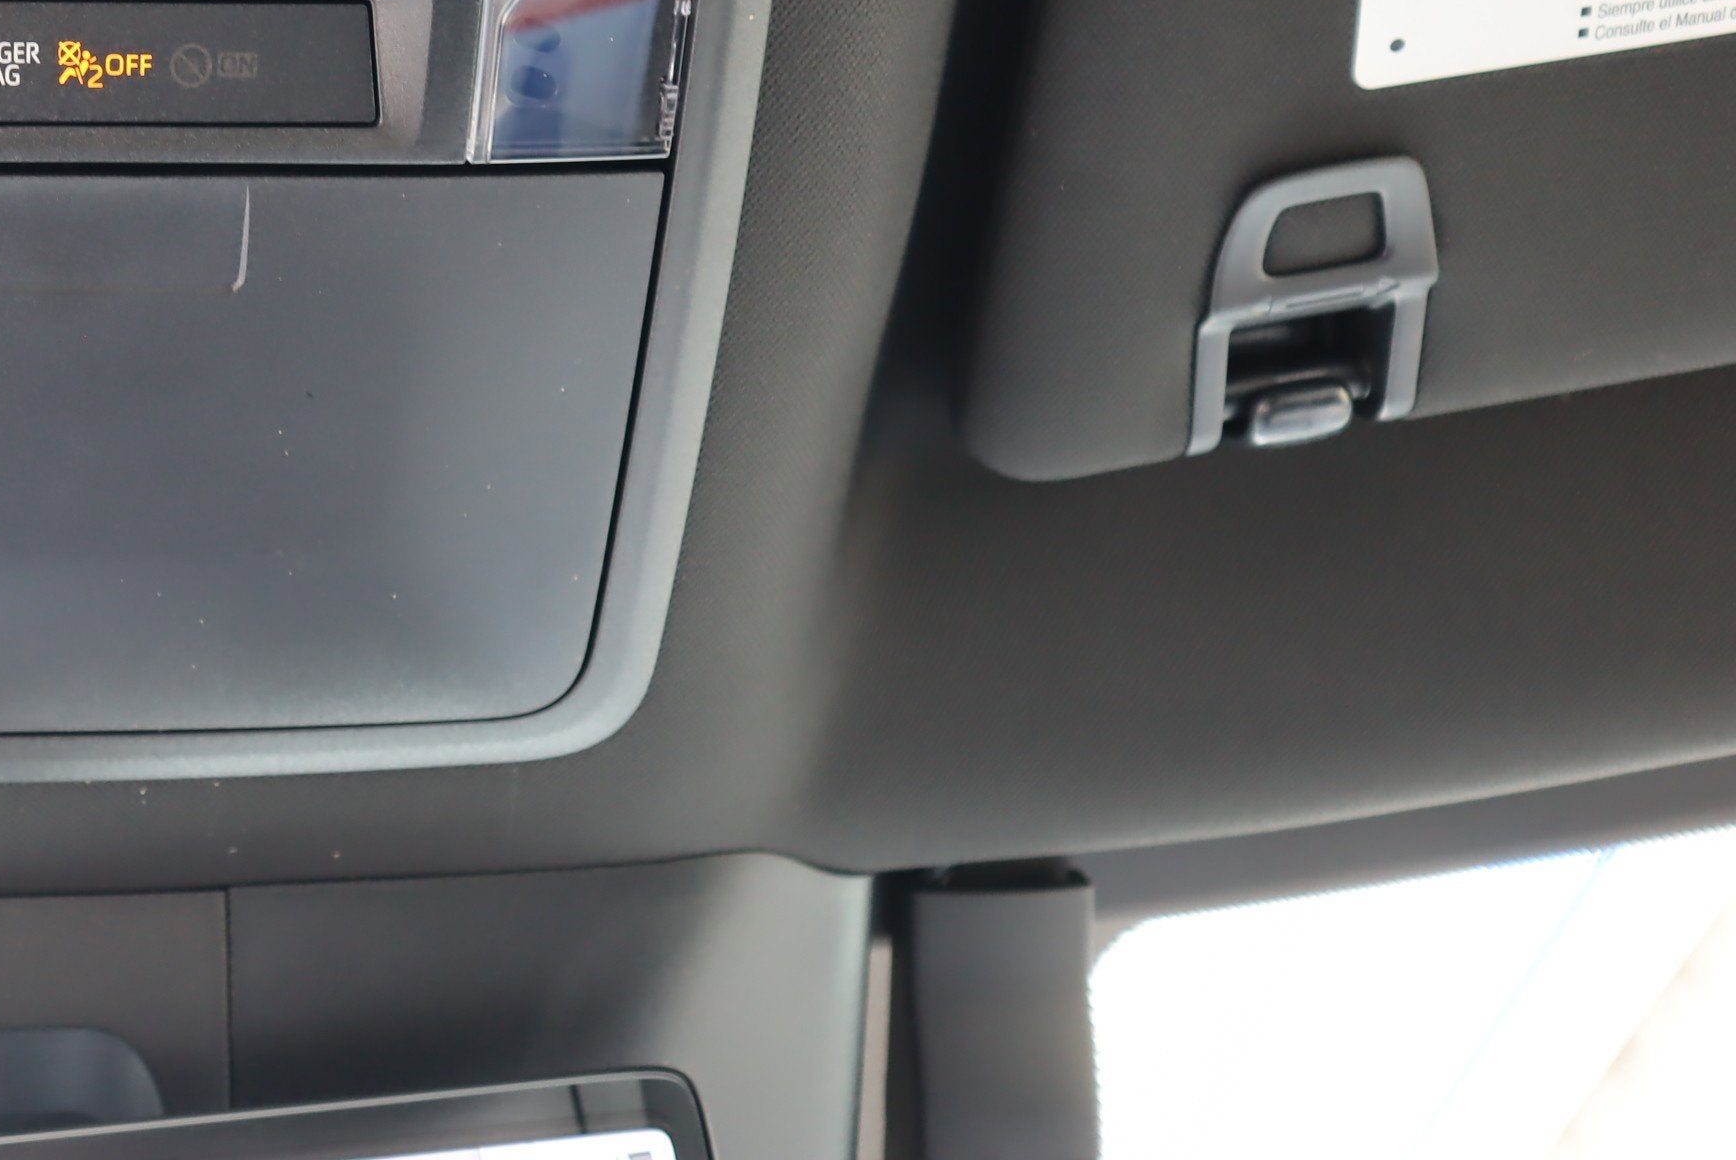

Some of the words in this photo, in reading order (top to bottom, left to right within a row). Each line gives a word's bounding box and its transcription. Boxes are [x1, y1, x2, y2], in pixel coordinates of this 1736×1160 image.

[1598, 0, 1655, 19] Siempre
[1595, 18, 1655, 40] Consulte
[1659, 16, 1672, 31] el
[1675, 7, 1727, 28] Manual
[105, 54, 153, 77] OFF
